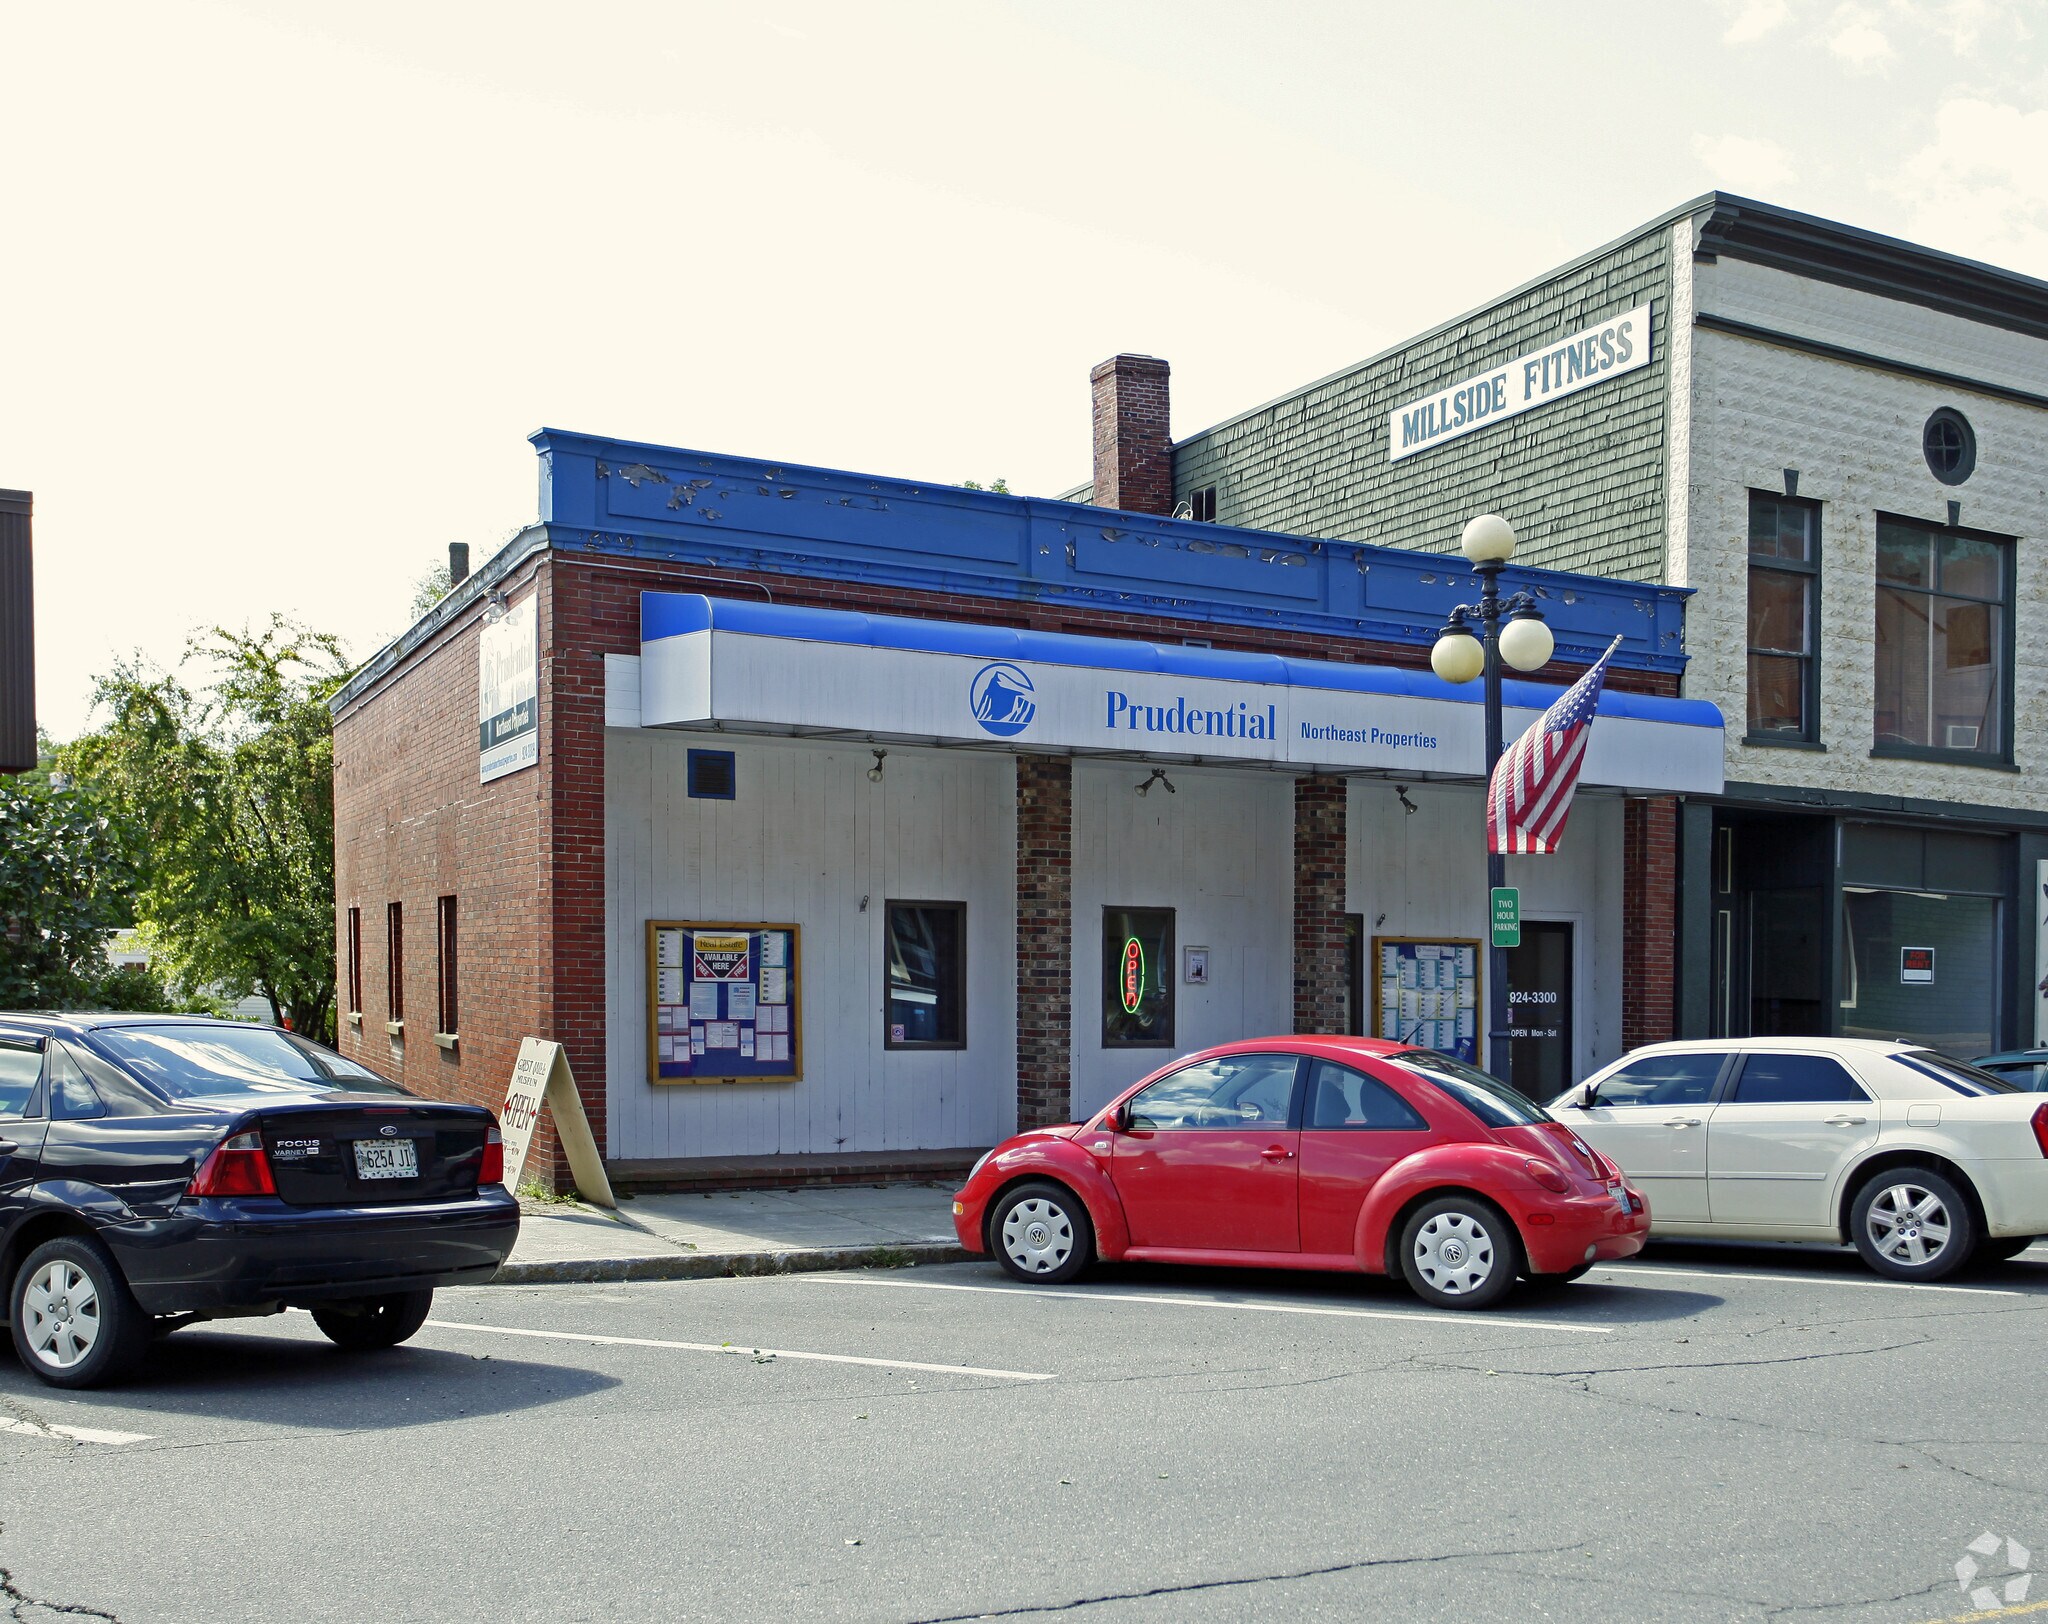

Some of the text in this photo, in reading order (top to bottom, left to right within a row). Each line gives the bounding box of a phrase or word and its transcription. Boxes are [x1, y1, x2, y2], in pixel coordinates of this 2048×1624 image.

[1401, 321, 1633, 448] MILLSIDE FITNESS
[1105, 691, 1277, 740] Prudential
[1301, 722, 1437, 749] Northeast Properties
[1497, 900, 1514, 909] TWO
[1496, 911, 1515, 920] HOUR
[1494, 922, 1518, 931] PARKING
[703, 953, 739, 962] AVAILABLE
[696, 962, 710, 977] FREE
[712, 962, 730, 970] HERE
[733, 963, 747, 978] FREE
[1509, 991, 1557, 1004] 924-3300
[1510, 1029, 1528, 1037] OPEN
[1531, 1029, 1544, 1037] Mon
[1547, 1029, 1557, 1037] Sat
[506, 1092, 536, 1131] OPEN
[276, 1139, 320, 1148] FOCUS
[366, 1149, 395, 1168] 6254
